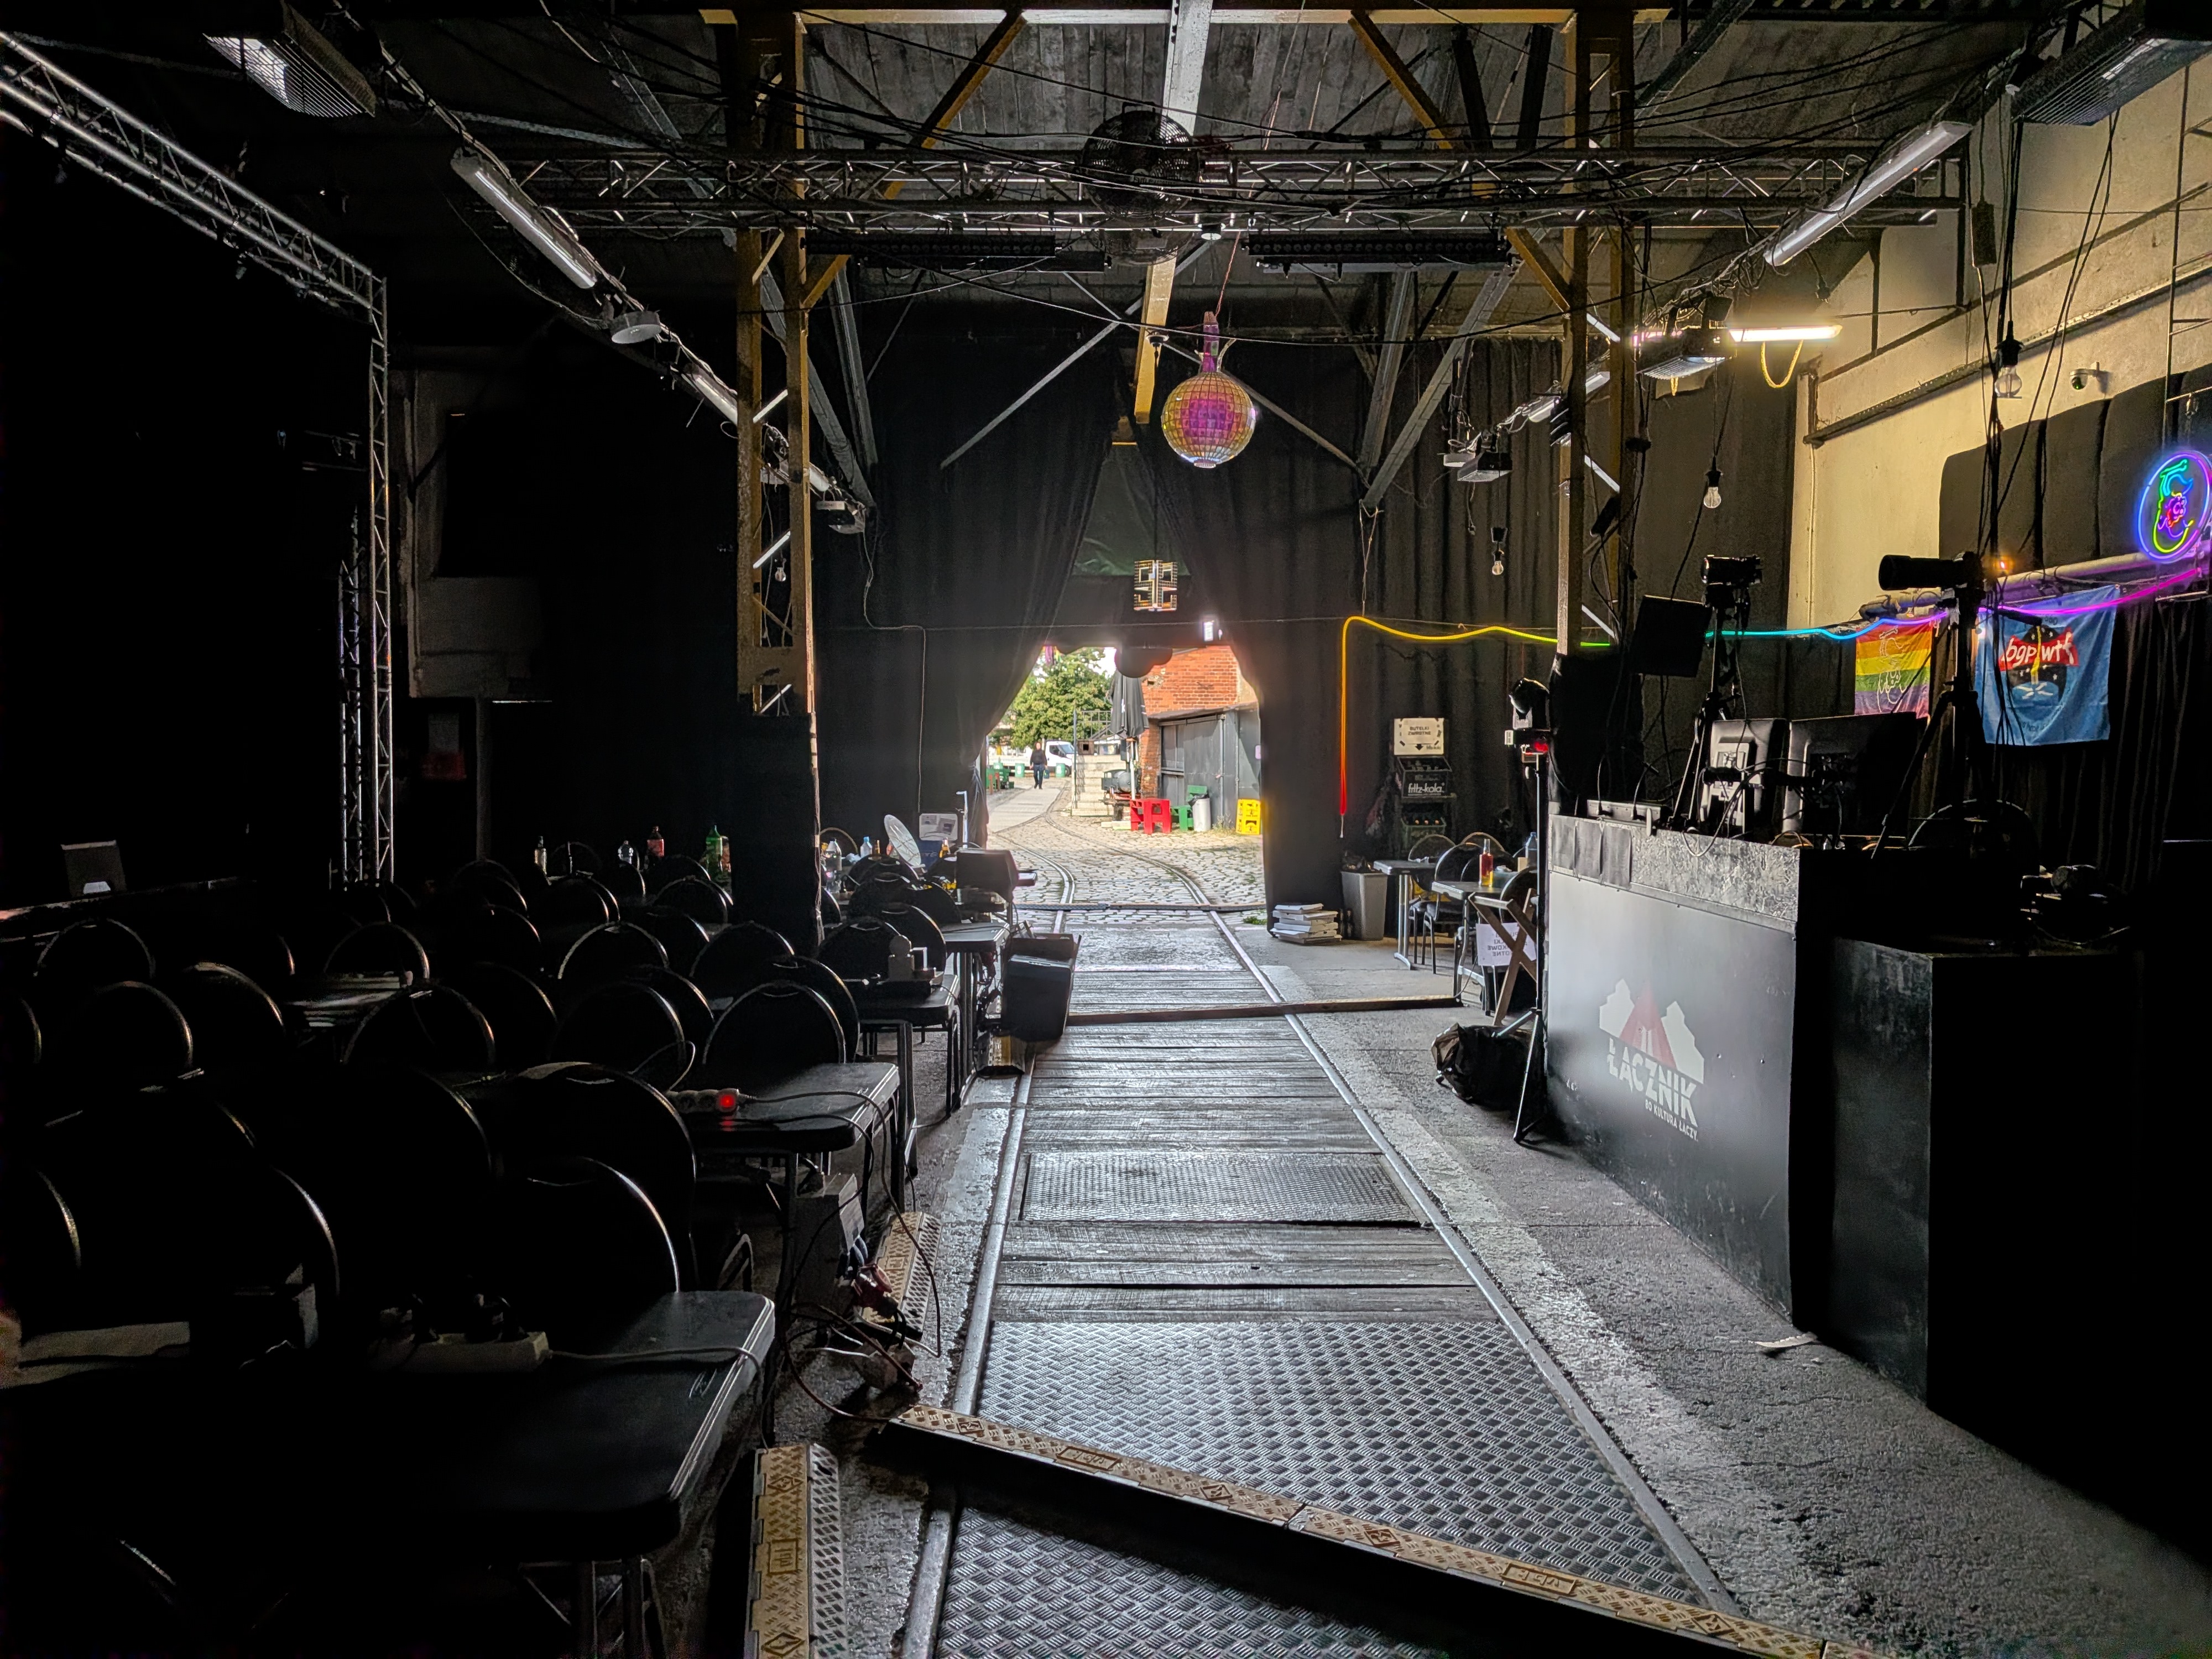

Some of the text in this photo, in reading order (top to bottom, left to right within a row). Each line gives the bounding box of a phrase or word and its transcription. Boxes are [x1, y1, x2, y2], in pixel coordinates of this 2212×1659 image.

[1607, 1037, 1698, 1127] ŁĄCZNIK
[1645, 1099, 1652, 1112] BO
[1653, 1104, 1678, 1129] KULTURA
